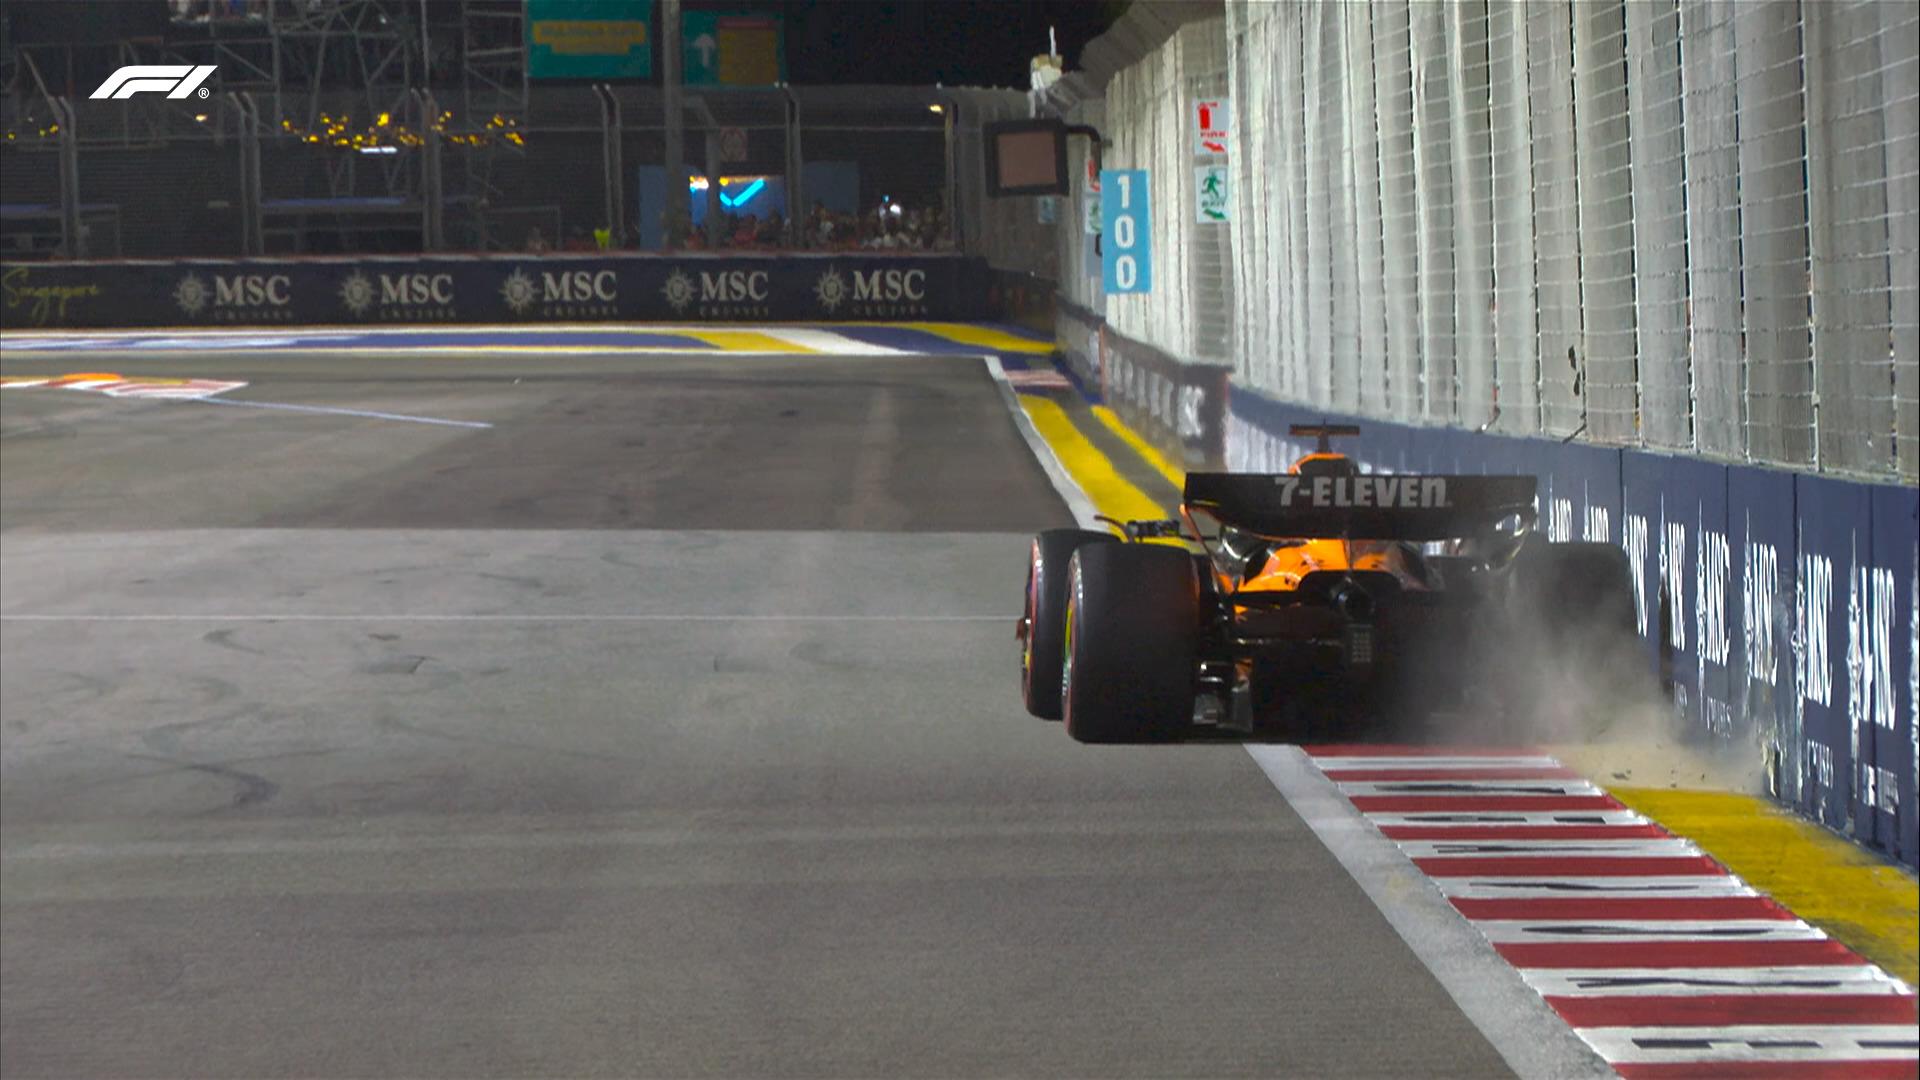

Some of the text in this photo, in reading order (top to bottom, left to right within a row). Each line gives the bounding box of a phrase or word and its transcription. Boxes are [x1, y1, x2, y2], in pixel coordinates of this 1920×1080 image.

[1115, 175, 1137, 290] 100
[214, 275, 291, 305] MSC
[380, 274, 454, 304] MSC
[542, 271, 618, 300] MSC
[701, 271, 768, 300] MSC
[853, 269, 926, 300] MSC
